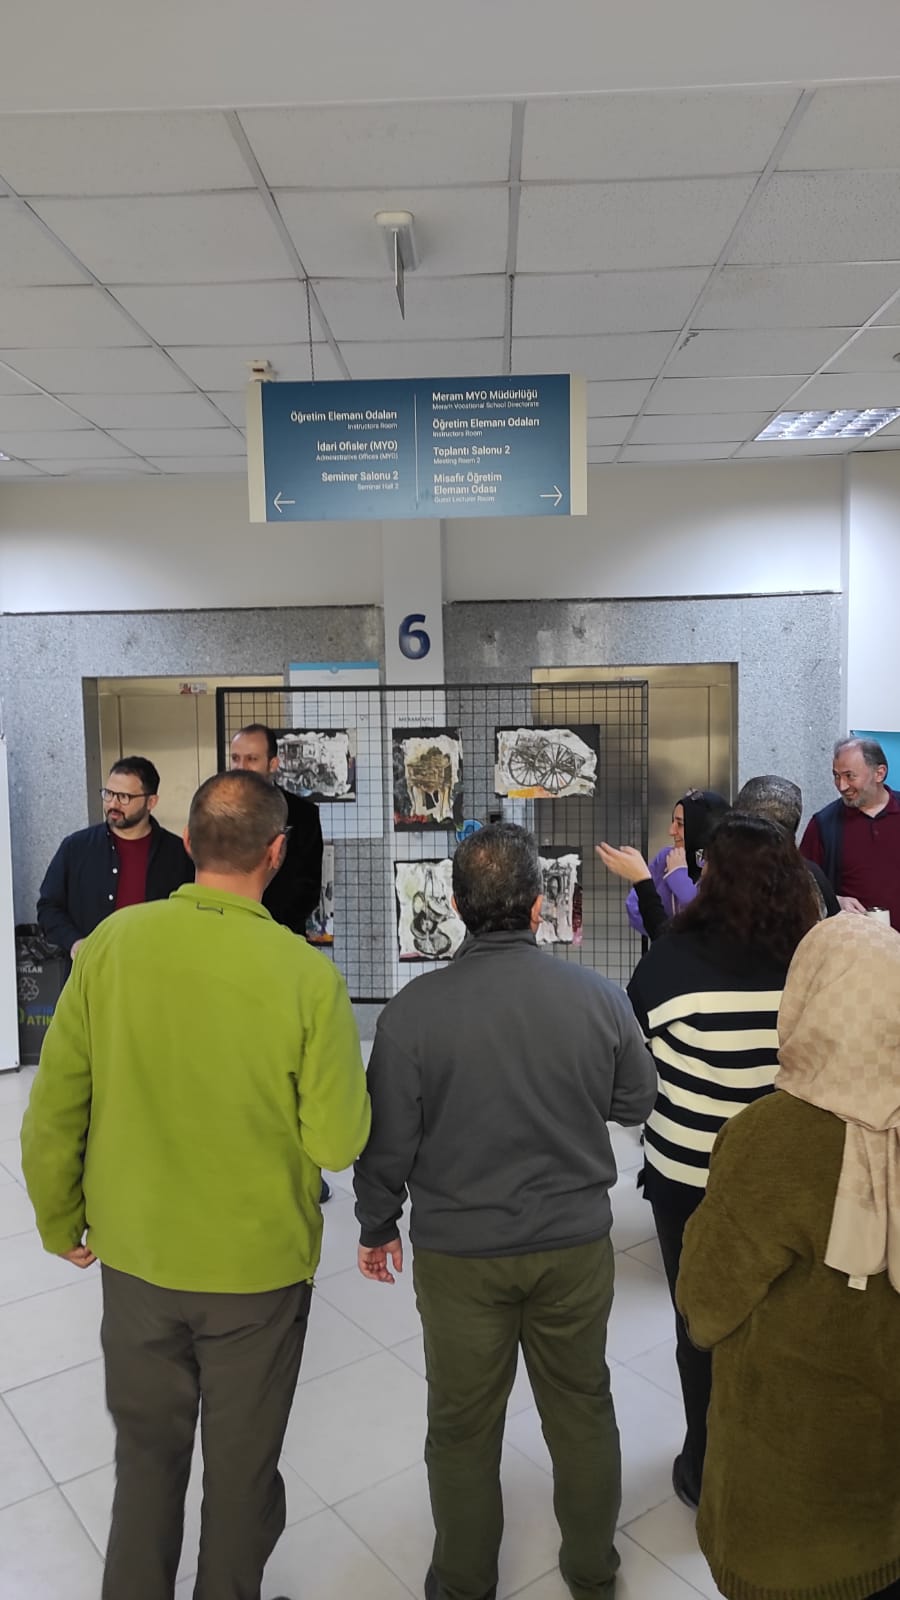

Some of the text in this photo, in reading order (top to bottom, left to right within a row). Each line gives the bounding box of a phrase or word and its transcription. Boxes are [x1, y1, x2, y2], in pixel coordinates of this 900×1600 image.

[433, 390, 538, 401] Meram MYO Müdürlüğü
[290, 410, 398, 424] Öğretim Elemanı Odaları
[433, 416, 540, 430] Öğretim Elemanı Odaları
[317, 440, 398, 452] İdari Ofisler (MYO)
[433, 445, 510, 457] Toplantı Salonu 2
[360, 471, 390, 480] Salonu
[392, 470, 398, 480] 2
[434, 472, 502, 484] Misafir Öğretim
[434, 484, 496, 494] Elemanı Odası
[399, 614, 430, 660] 6
